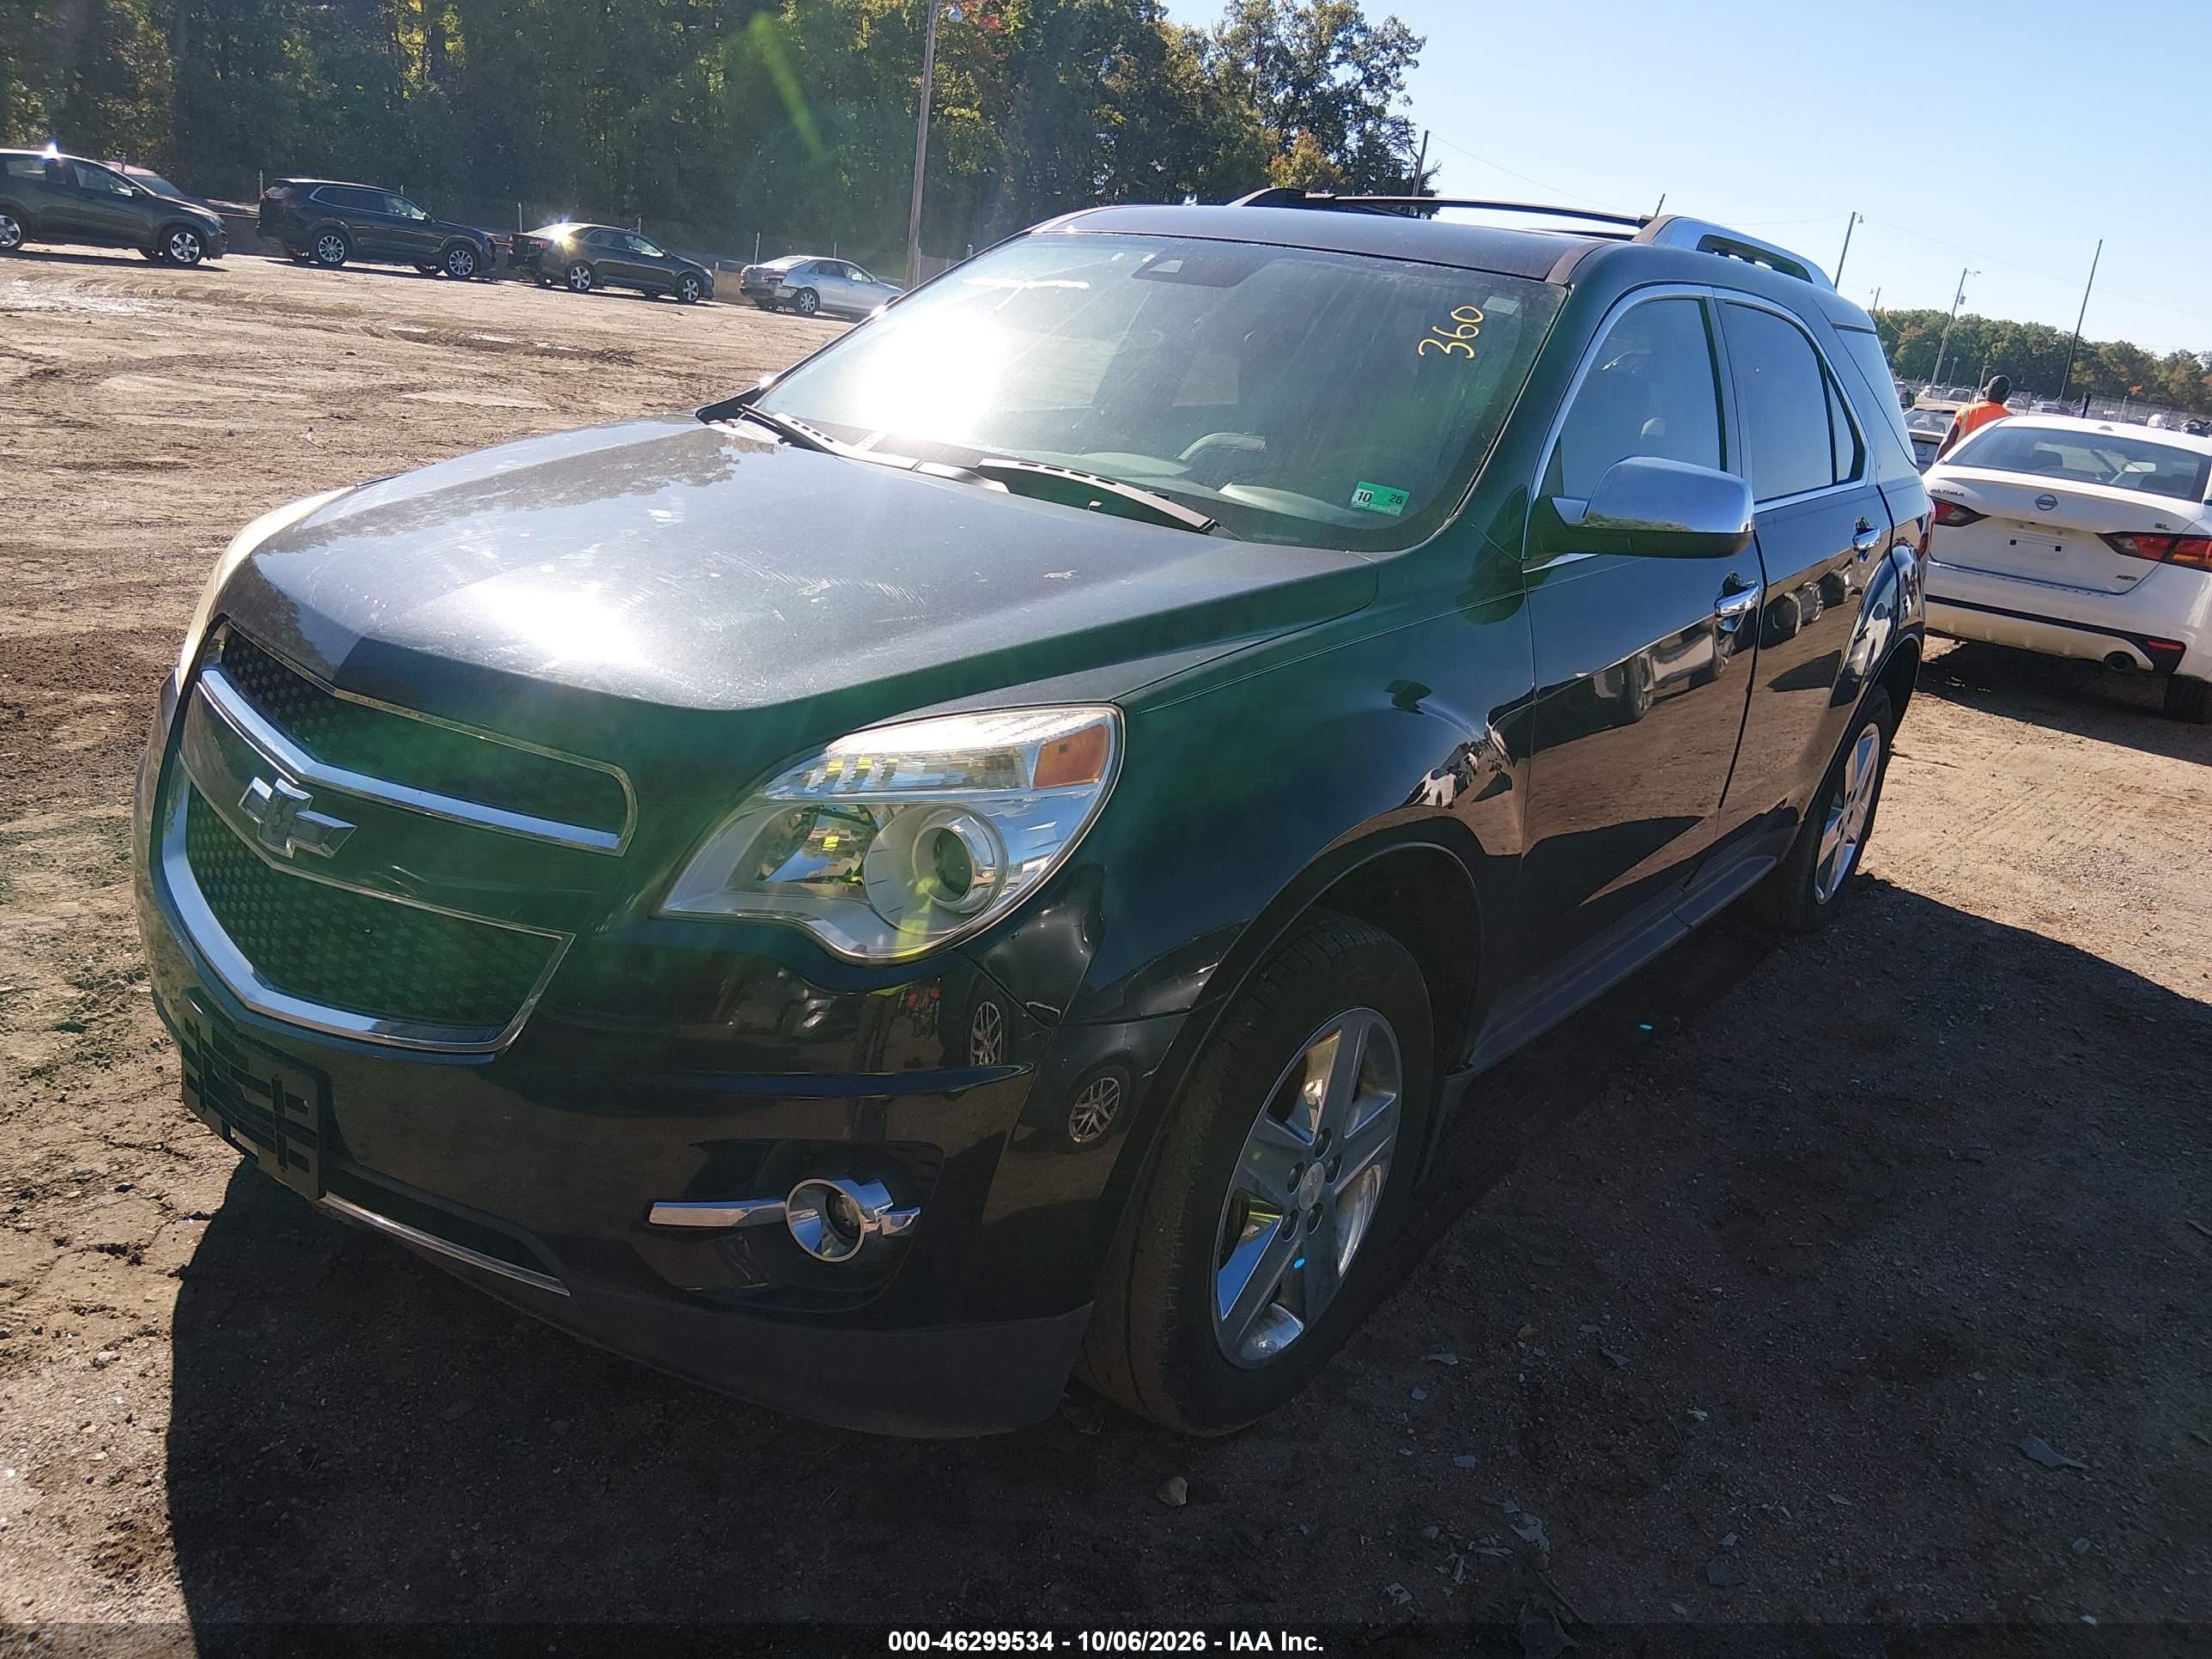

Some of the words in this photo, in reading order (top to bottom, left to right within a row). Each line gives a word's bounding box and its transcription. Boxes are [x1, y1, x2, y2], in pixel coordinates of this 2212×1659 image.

[1418, 306, 1484, 359] 360
[1357, 490, 1372, 503] 10
[1388, 493, 1403, 505] 26
